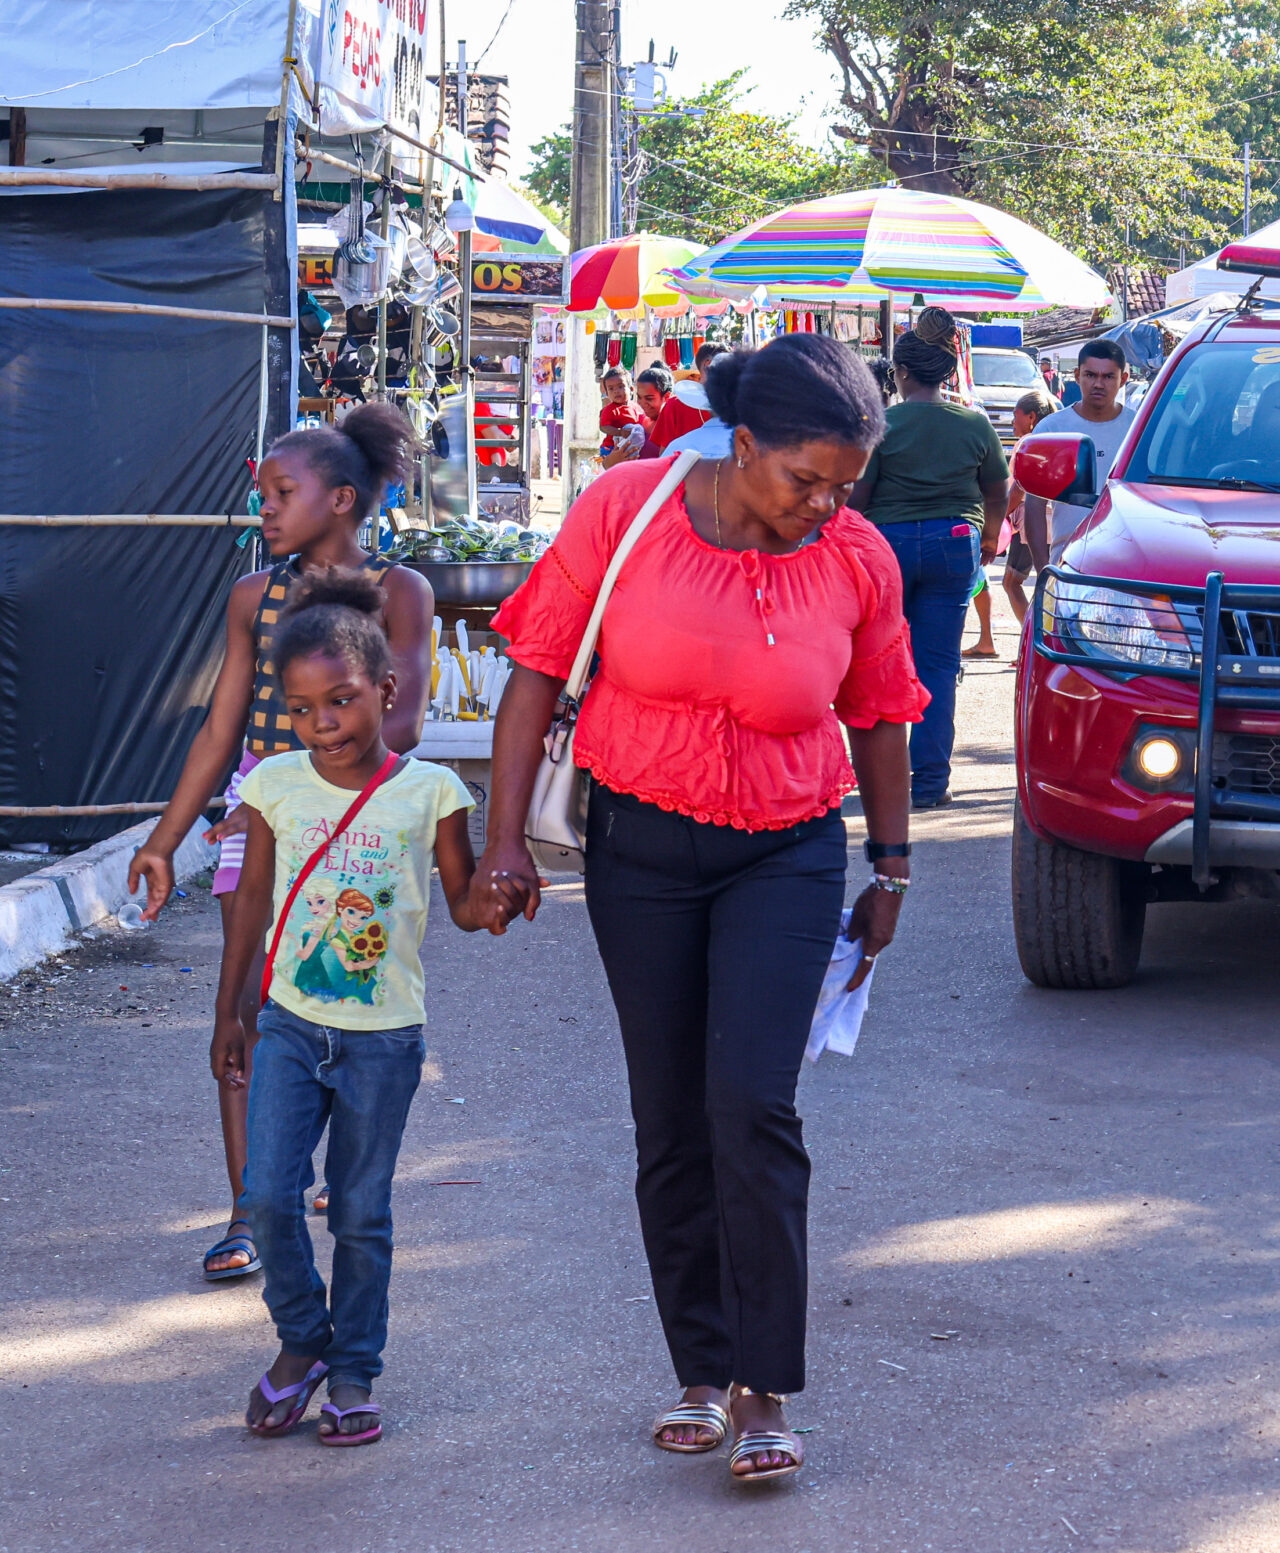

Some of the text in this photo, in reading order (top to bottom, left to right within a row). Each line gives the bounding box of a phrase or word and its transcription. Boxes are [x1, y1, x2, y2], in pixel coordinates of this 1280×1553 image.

[342, 9, 381, 90] PEÇAS
[302, 817, 381, 849] Anna
[312, 845, 375, 874] Elsa
[360, 847, 389, 860] and
